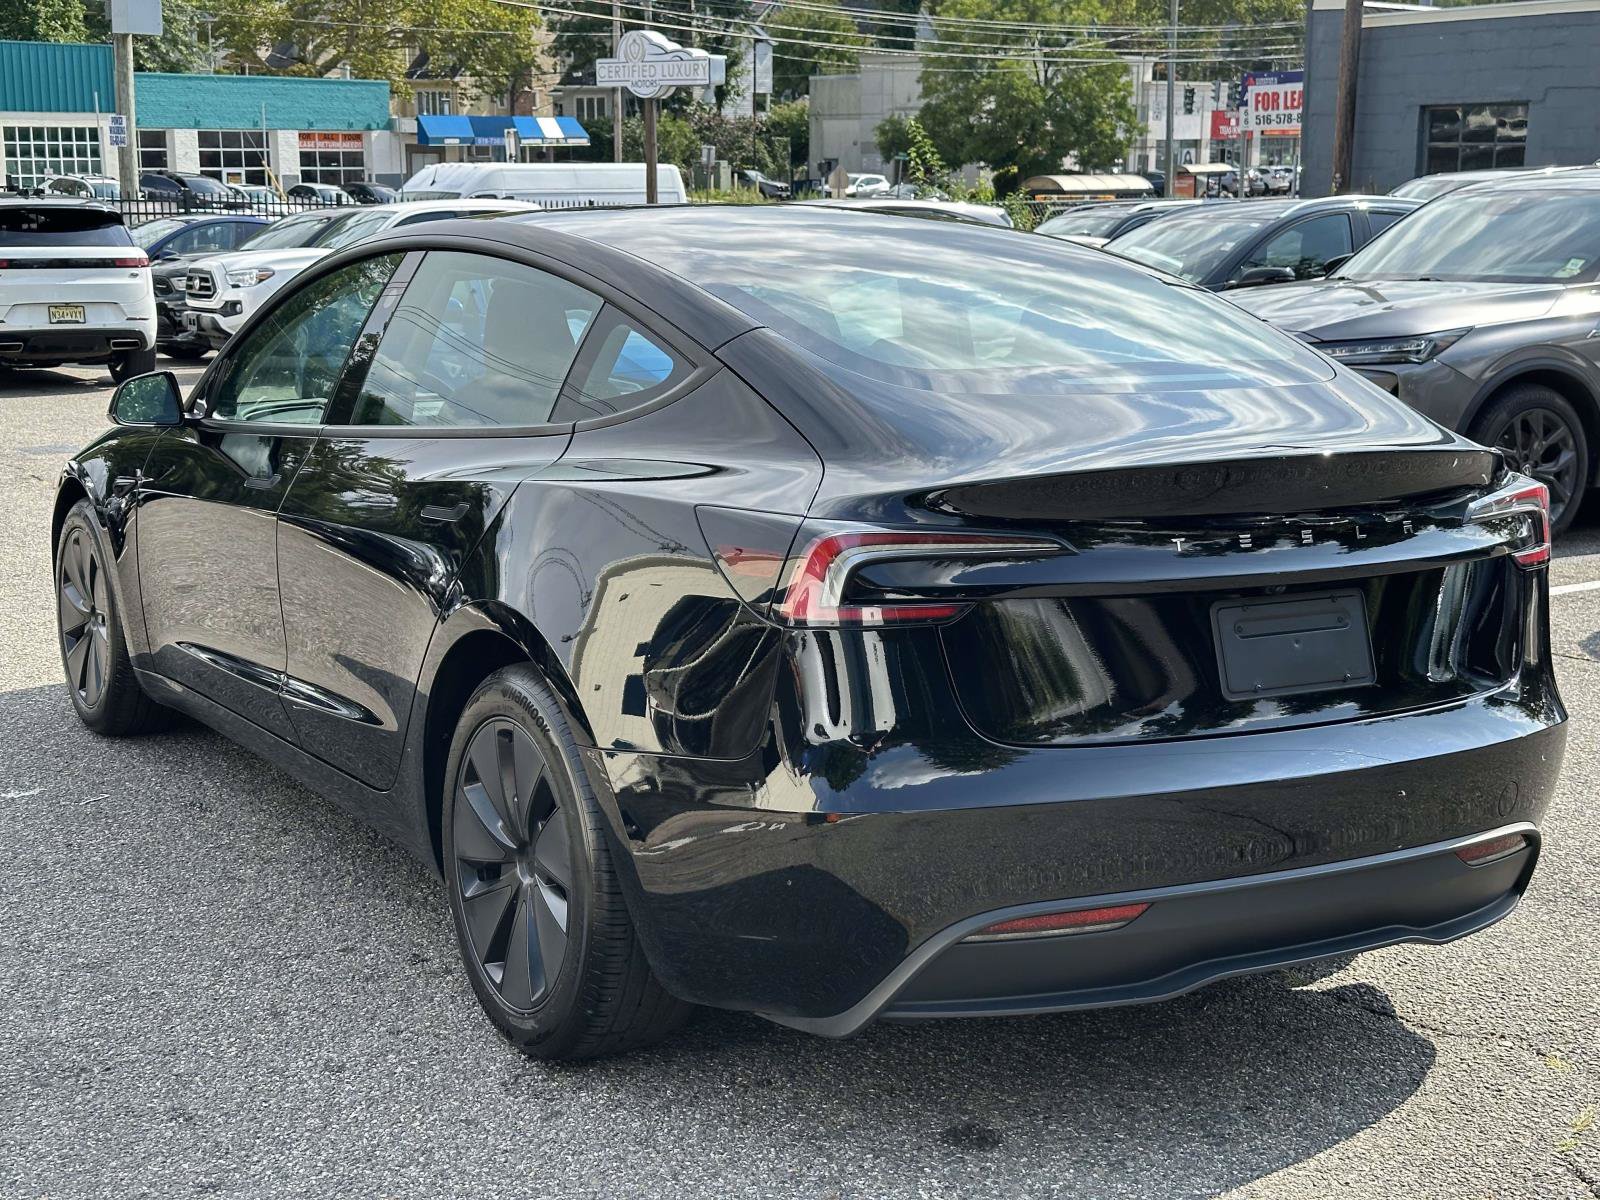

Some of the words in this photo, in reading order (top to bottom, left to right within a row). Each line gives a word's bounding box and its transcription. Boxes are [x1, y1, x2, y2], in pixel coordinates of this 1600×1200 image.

[598, 65, 656, 79] CERTIFIED
[662, 63, 708, 78] LUXURY
[631, 80, 657, 88] MOTORS
[1254, 91, 1280, 112] FOR
[1171, 519, 1414, 552] TESLA
